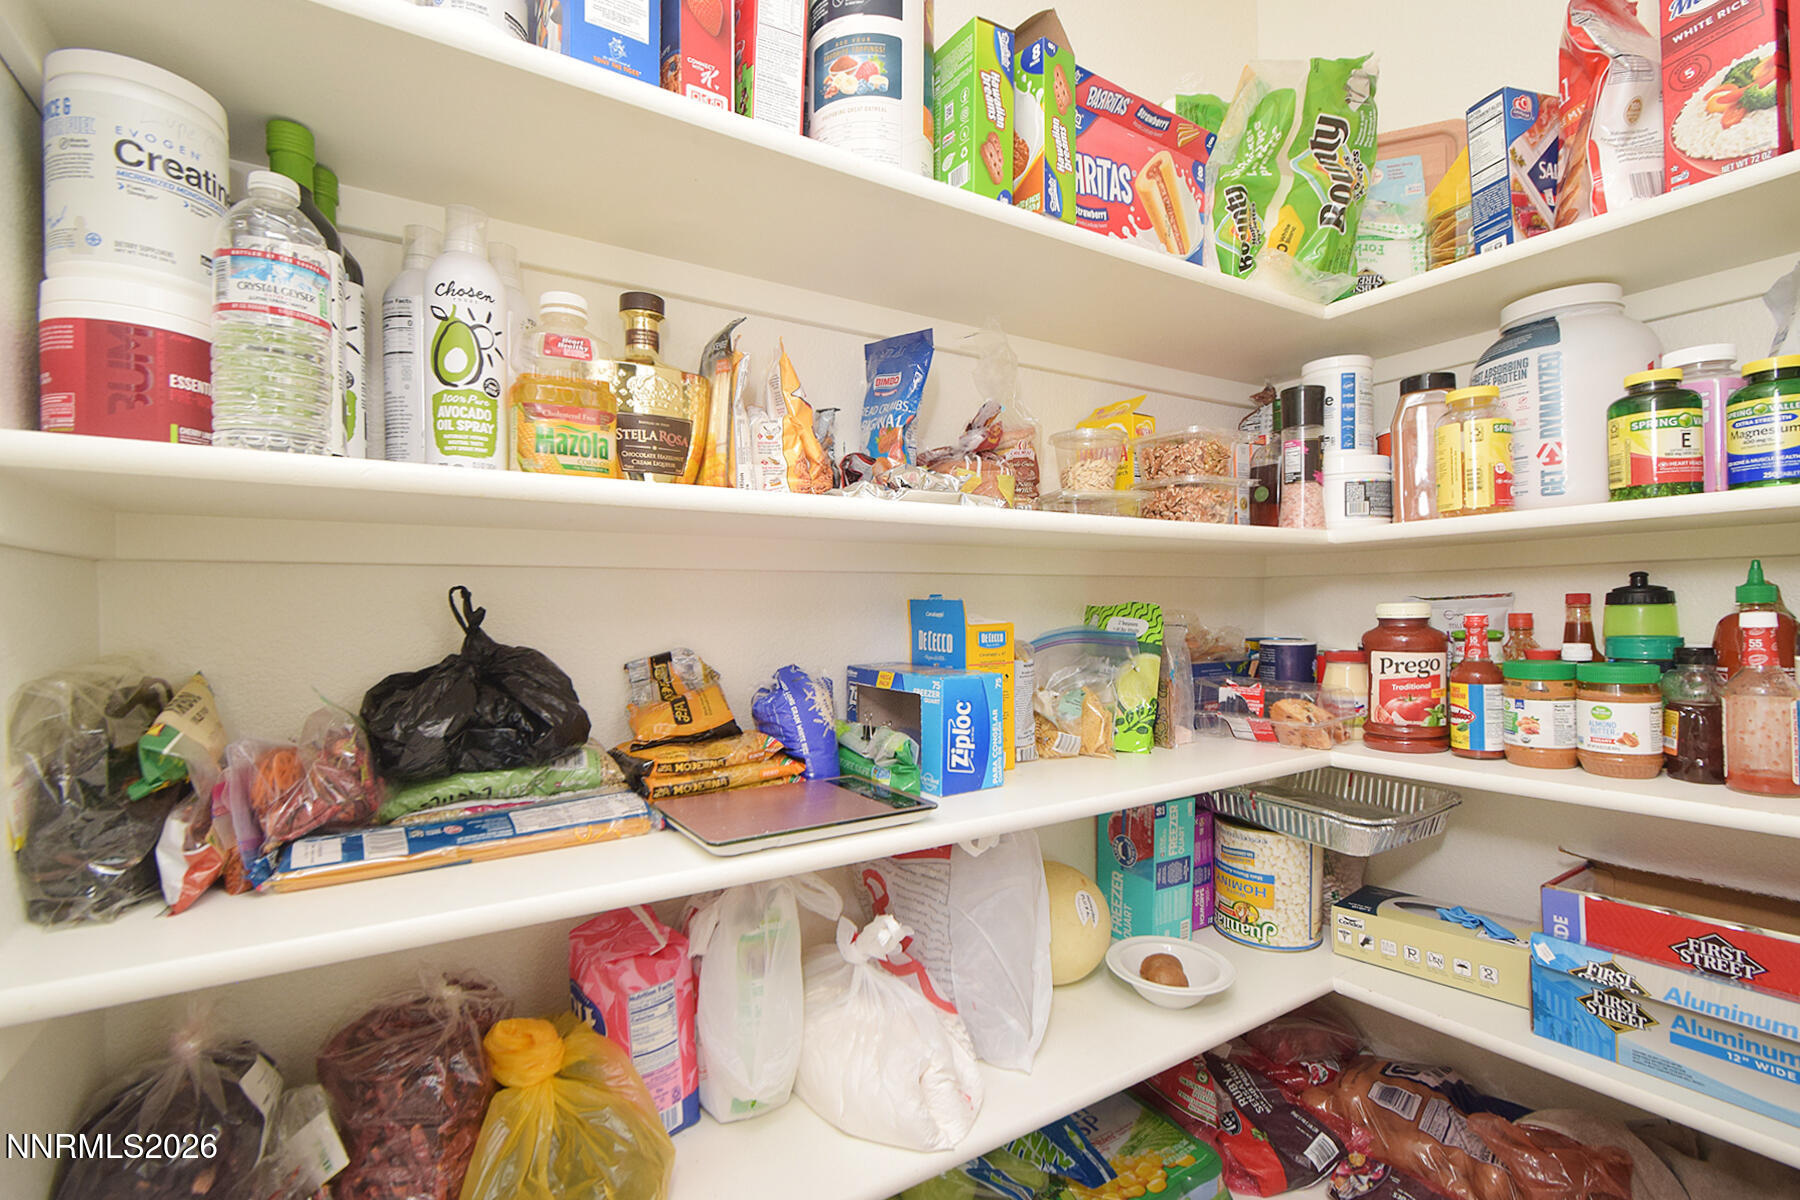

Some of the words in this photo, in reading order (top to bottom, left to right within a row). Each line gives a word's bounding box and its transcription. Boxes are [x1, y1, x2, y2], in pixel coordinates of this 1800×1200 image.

[1671, 15, 1715, 44] WHITE
[1717, 0, 1751, 20] RICE
[593, 55, 609, 66] TONY
[612, 62, 622, 71] THE
[623, 66, 640, 77] TIGER
[686, 56, 715, 71] CONNECT
[1684, 67, 1696, 80] 5
[981, 71, 996, 121] Dreams
[990, 71, 1005, 129] Hawaiian
[1137, 106, 1170, 130] Strawberry
[115, 125, 201, 161] EVOGEN
[1051, 117, 1066, 174] Hawaiian
[1060, 125, 1073, 173] Dreams
[113, 138, 229, 207] Creatin
[1309, 113, 1351, 235] Bounty
[1721, 161, 1735, 174] NET
[1736, 158, 1749, 169] WT
[1750, 153, 1761, 164] 72
[1762, 150, 1772, 160] OZ
[116, 170, 175, 191] MICRONIZED
[1075, 152, 1133, 205] RRITAS
[1224, 184, 1253, 274] Bounty
[231, 249, 262, 257] BOTTLED
[279, 255, 293, 263] THE
[296, 259, 320, 273] SOURCE
[236, 280, 279, 294] CRYSTAL
[280, 287, 316, 304] GEYSER
[434, 280, 495, 304] Chosen
[557, 342, 590, 353] Healthy
[562, 337, 584, 347] Heart
[1484, 356, 1529, 378] ABSORBING
[1492, 369, 1528, 386] PROTEIN
[169, 373, 212, 396] ESSENT
[875, 376, 900, 387] BIMBO
[442, 393, 467, 404] 100%
[467, 395, 491, 406] Pure
[1537, 350, 1564, 439] DYMATIZED
[437, 405, 492, 421] AVOCADO
[542, 409, 581, 422] Cholesterol
[1754, 414, 1792, 424] STRENGTH
[1768, 402, 1800, 412] VALLE
[436, 420, 455, 432] OIL
[455, 420, 495, 435] SPRAY
[1631, 417, 1678, 431] SPRING
[535, 427, 609, 460] Mazola
[616, 427, 658, 442] STELLA
[659, 429, 689, 448] ROSA
[1682, 432, 1691, 448] E
[621, 450, 656, 460] CHOCOLATE
[657, 452, 685, 462] HAZELNUT
[631, 458, 652, 466] CREAM
[652, 460, 676, 468] LIQUEUR
[1540, 470, 1566, 497] GET
[927, 630, 953, 654] CECCO
[988, 633, 1004, 643] CECCO
[1748, 638, 1763, 649] 55
[1379, 657, 1441, 679] Prego
[934, 680, 941, 690] 75
[995, 677, 1002, 689] 75
[1391, 681, 1432, 692] Traditional
[789, 706, 801, 726] GRAIN
[795, 723, 806, 743] WHITE
[950, 700, 976, 769] Ziploc
[1588, 720, 1617, 728] ALMOND
[1590, 727, 1615, 735] BUTTER
[674, 777, 728, 795] MODERNA
[1168, 804, 1178, 856] FREEZER
[1216, 872, 1267, 899] HOMINY
[1111, 870, 1124, 935] FREEZER
[1123, 904, 1133, 938] QUART
[1214, 911, 1278, 945] Juanita's
[1338, 918, 1363, 929] Condor
[1687, 937, 1746, 963] FIRST
[1587, 960, 1635, 986] FIRST
[1679, 949, 1756, 981] STREET
[629, 989, 657, 1001] Nutrition
[657, 981, 673, 992] Facts
[1593, 989, 1641, 1015] FIRST
[1586, 999, 1648, 1031] STREET
[1663, 986, 1799, 1040] Aluminum
[1670, 1014, 1800, 1069] Aluminum
[1727, 1051, 1749, 1064] 12"
[1754, 1060, 1797, 1082] WIDE
[1223, 1062, 1264, 1114] SENSATION
[1223, 1075, 1249, 1108] RUBY
